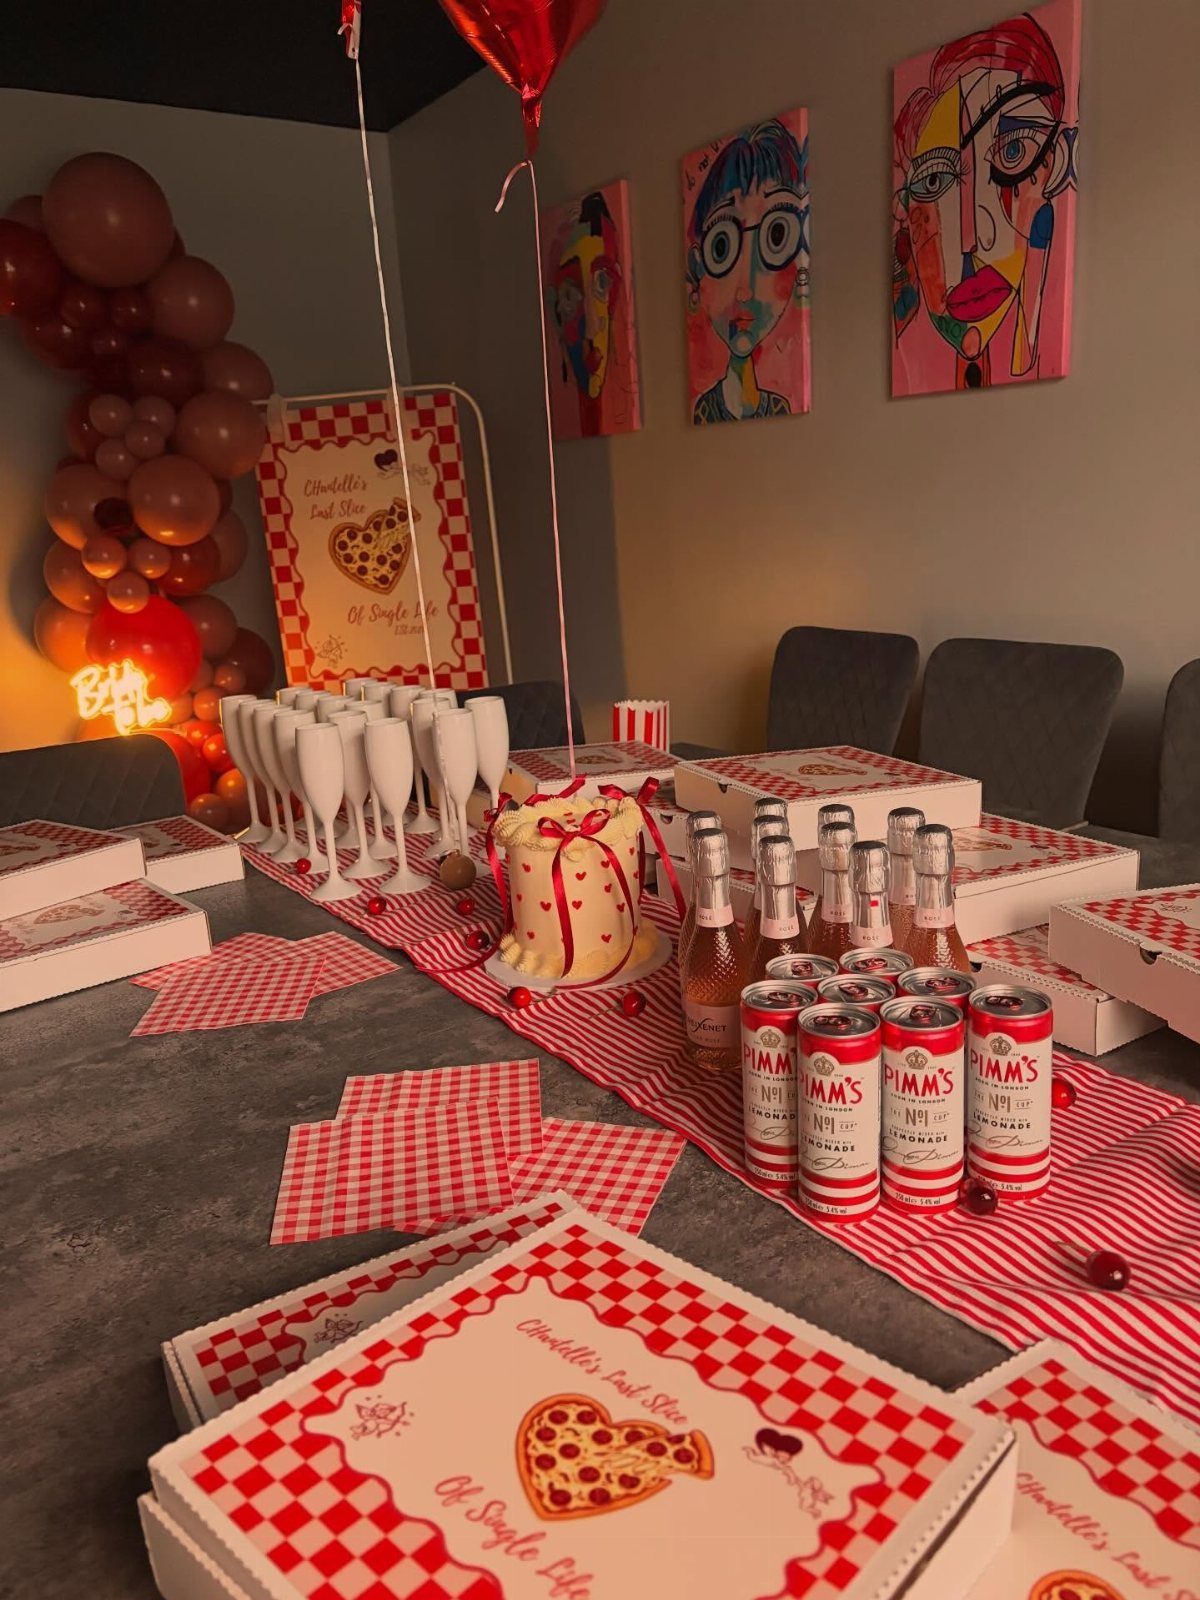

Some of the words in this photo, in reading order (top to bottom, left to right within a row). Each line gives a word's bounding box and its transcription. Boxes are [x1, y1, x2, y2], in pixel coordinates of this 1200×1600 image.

[310, 501, 335, 520] Last
[339, 499, 365, 518] Slice
[347, 605, 365, 626] Of
[369, 602, 408, 628] Single
[414, 600, 439, 621] Lfe
[744, 1043, 797, 1075] PIMM'
[970, 1048, 1038, 1083] PIMM'S
[884, 1063, 953, 1097] PIMM'S
[749, 1105, 797, 1120] LEMONAD
[973, 1112, 1031, 1129] LEMONADE
[803, 1135, 855, 1152] EMONADE
[889, 1129, 948, 1143] LEMONADE
[516, 1319, 602, 1374] CHantelle's
[601, 1370, 652, 1398] Last
[641, 1393, 688, 1424] Slice
[435, 1476, 484, 1507] Of
[465, 1500, 547, 1561] Single
[535, 1557, 594, 1600] Life
[1112, 1551, 1171, 1588] Last
